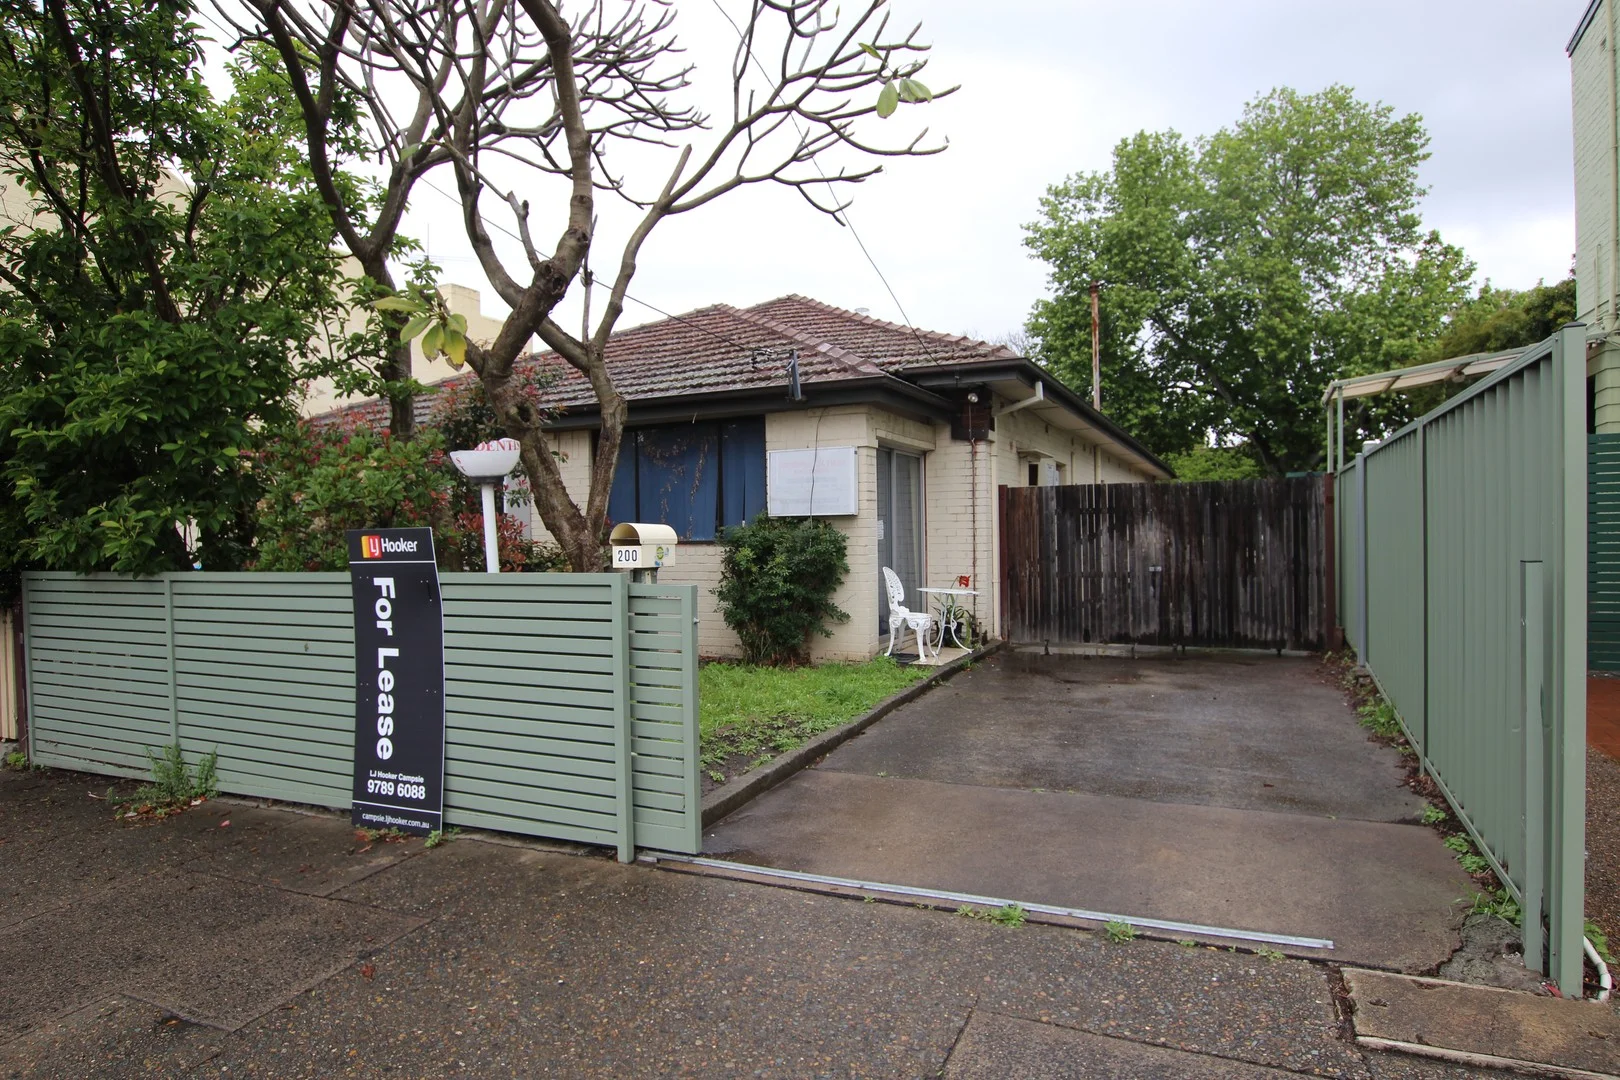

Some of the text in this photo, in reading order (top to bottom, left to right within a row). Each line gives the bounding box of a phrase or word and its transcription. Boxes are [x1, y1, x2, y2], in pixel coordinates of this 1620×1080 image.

[381, 538, 418, 552] Hooker
[617, 549, 638, 562] 200
[373, 577, 399, 760] For Lease
[369, 770, 424, 783] LJ Hooker Campsie
[367, 779, 426, 800] 9789 6088
[362, 813, 430, 828] campsie.ljhooker.com.au
